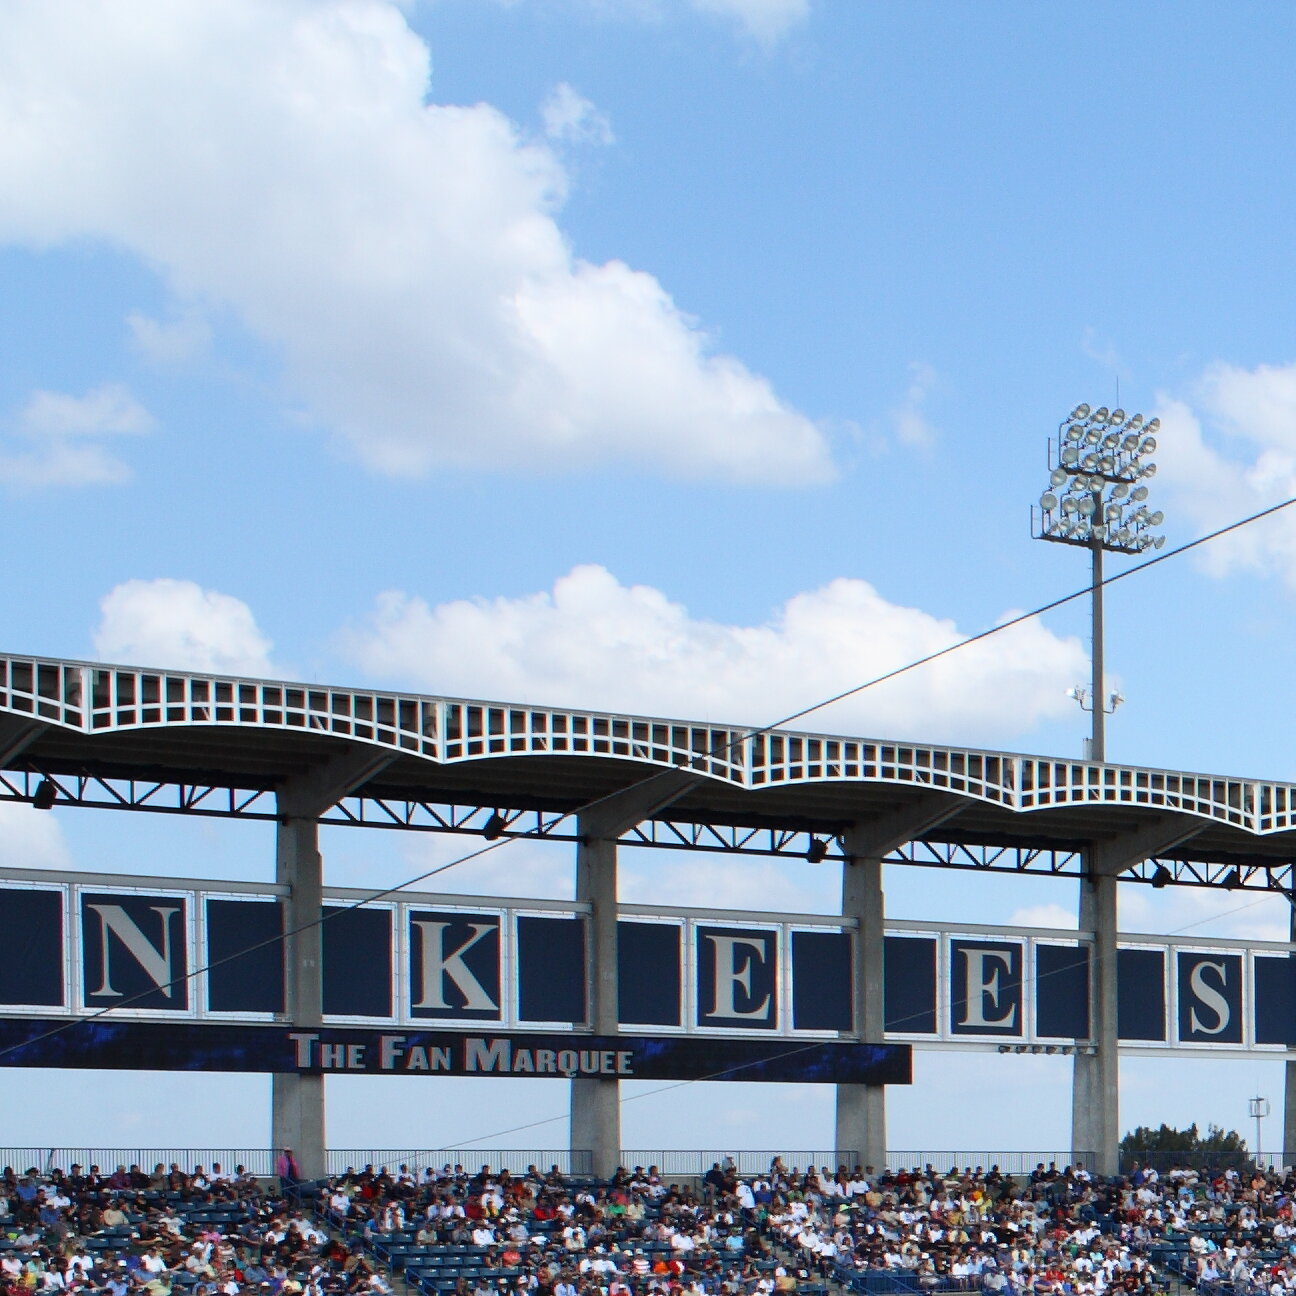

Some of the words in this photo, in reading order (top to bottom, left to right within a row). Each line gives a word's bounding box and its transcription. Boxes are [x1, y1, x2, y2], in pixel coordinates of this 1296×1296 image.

[87, 903, 181, 998] N
[411, 921, 499, 1011] K
[706, 935, 771, 1020] E
[958, 948, 1016, 1029] E
[1189, 962, 1231, 1035] S
